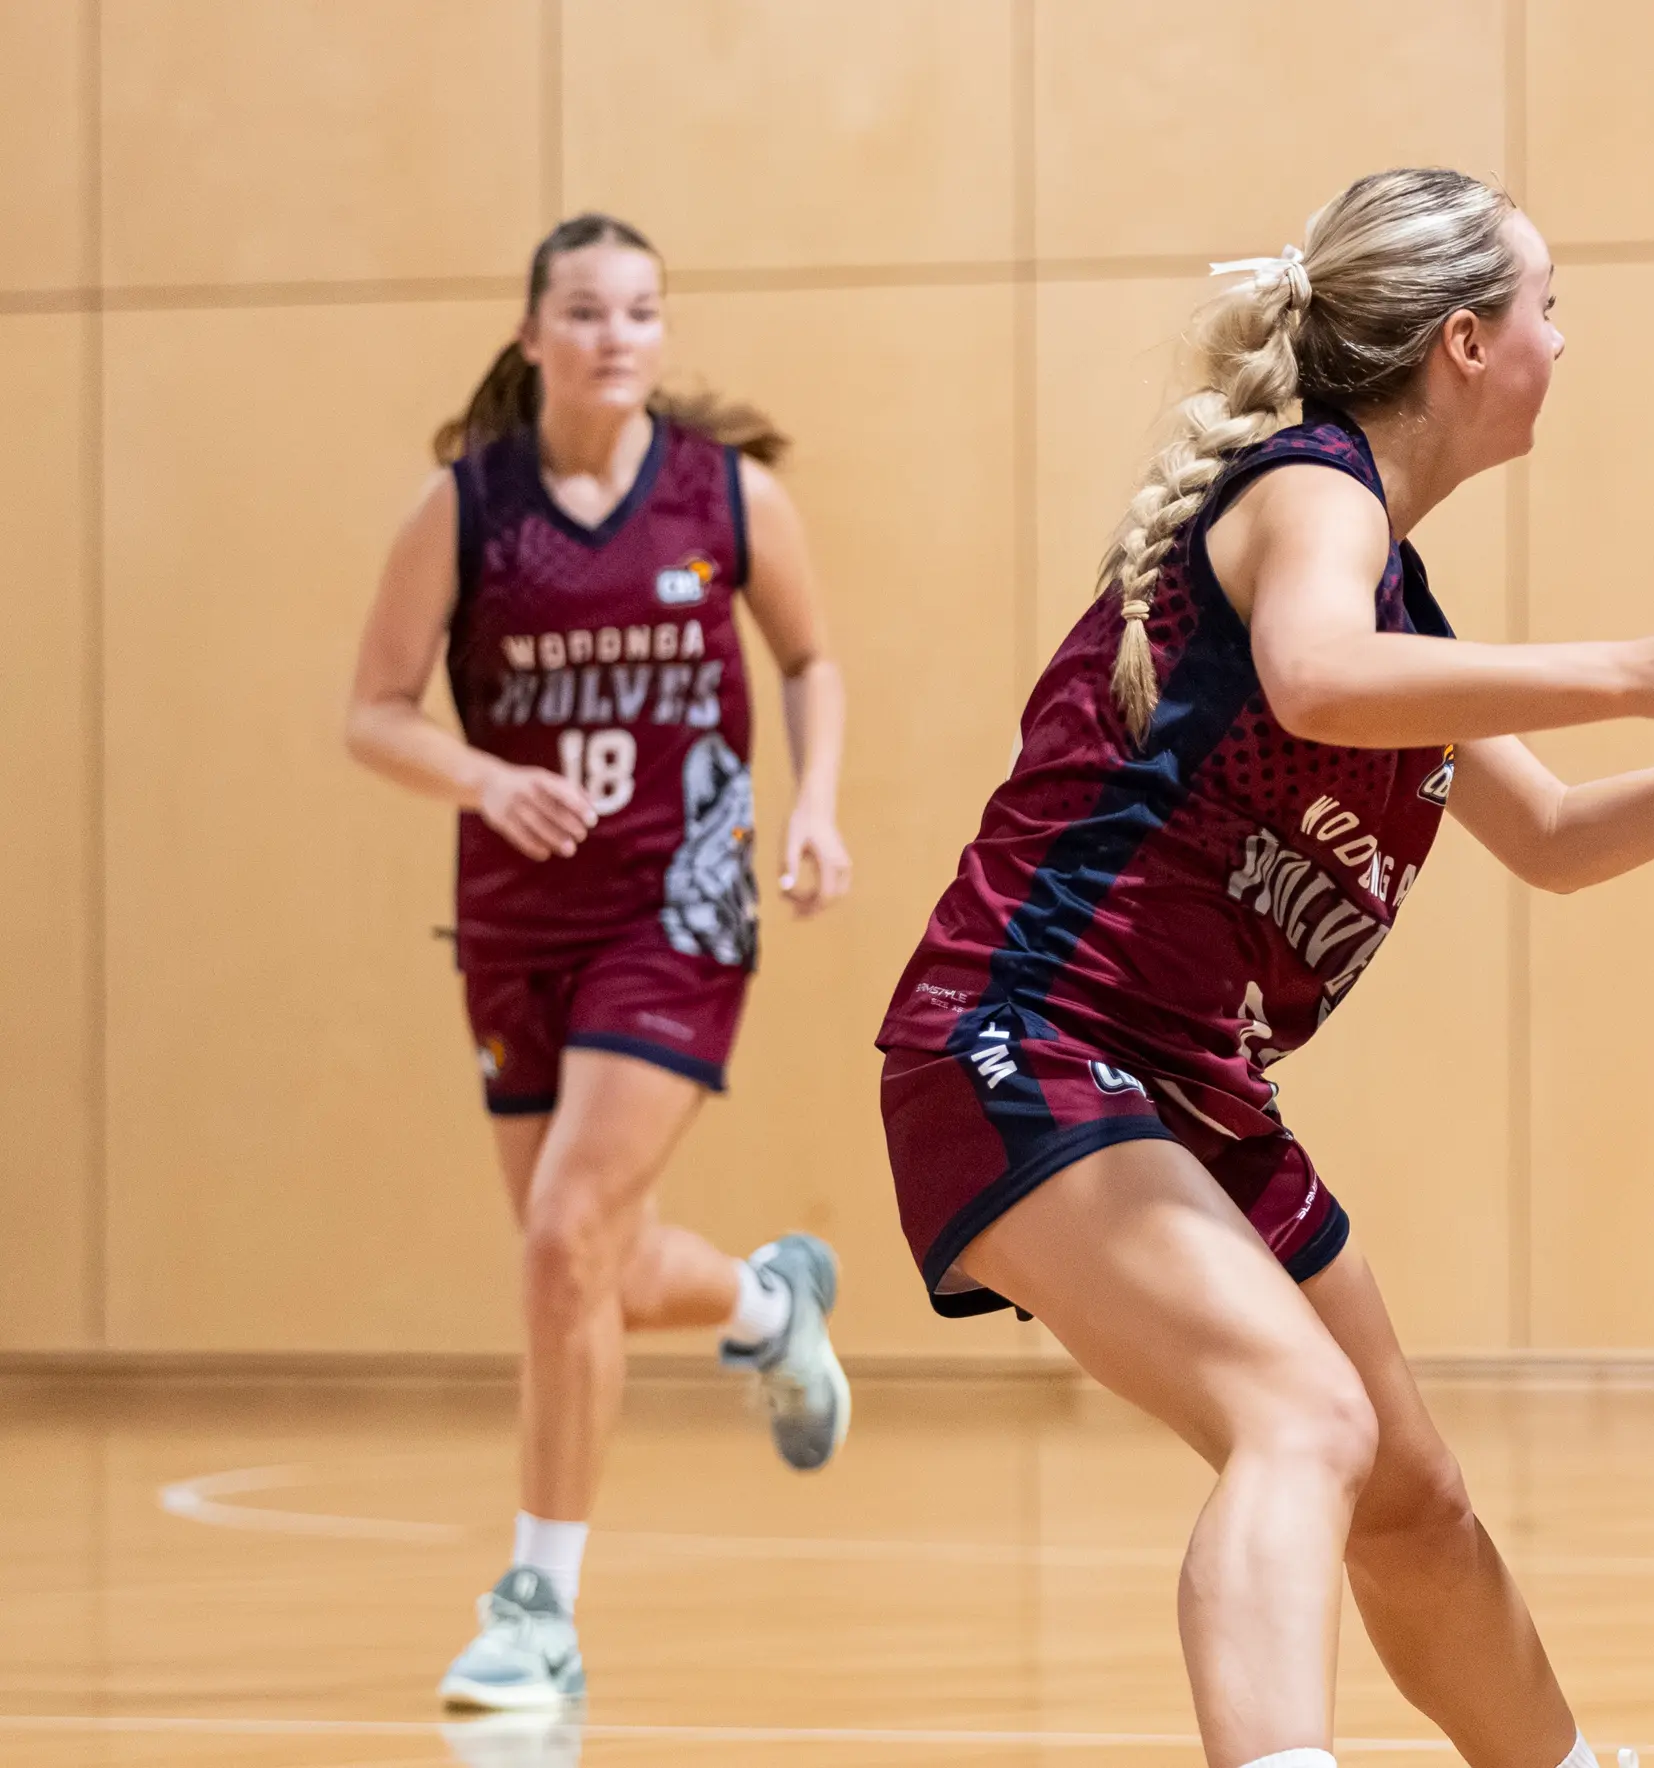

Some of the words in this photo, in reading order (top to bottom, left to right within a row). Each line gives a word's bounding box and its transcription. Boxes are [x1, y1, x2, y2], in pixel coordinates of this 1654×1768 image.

[501, 619, 705, 671] WODONGA
[488, 659, 725, 728] WOLVES
[557, 728, 637, 817] 18
